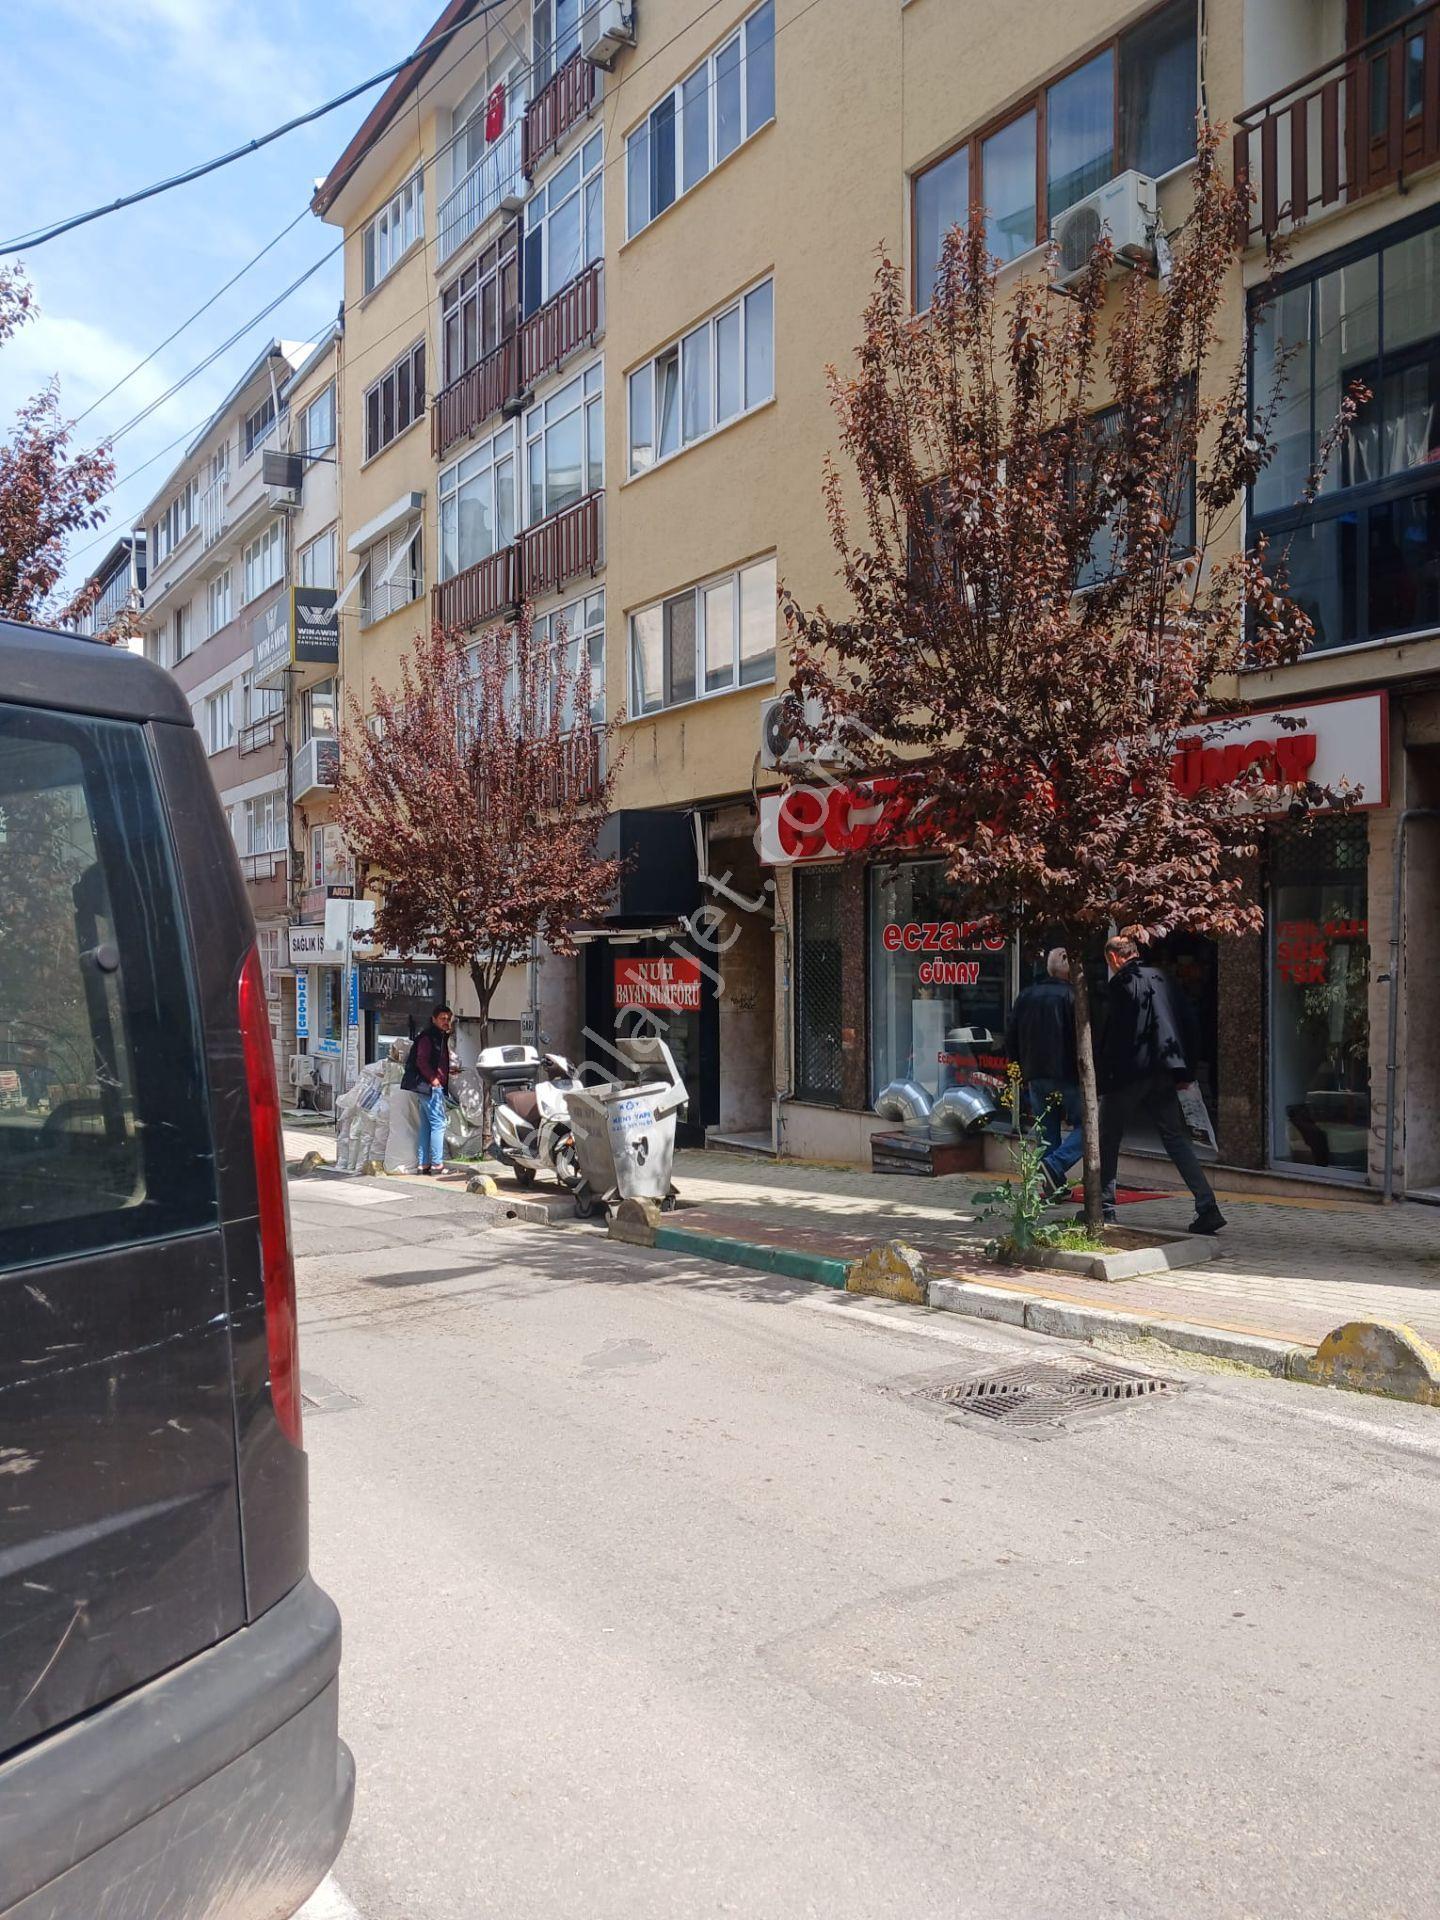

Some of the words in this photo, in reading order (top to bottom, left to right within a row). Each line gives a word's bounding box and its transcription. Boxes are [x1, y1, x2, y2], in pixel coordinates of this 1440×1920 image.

[297, 628, 337, 637] WINAWIN
[292, 935, 316, 952] SAĞLIK
[638, 963, 674, 980] NUH
[919, 957, 979, 984] GÜNAY
[616, 984, 648, 1004] BAYAN
[649, 979, 703, 1006] KUAFÖRÜ
